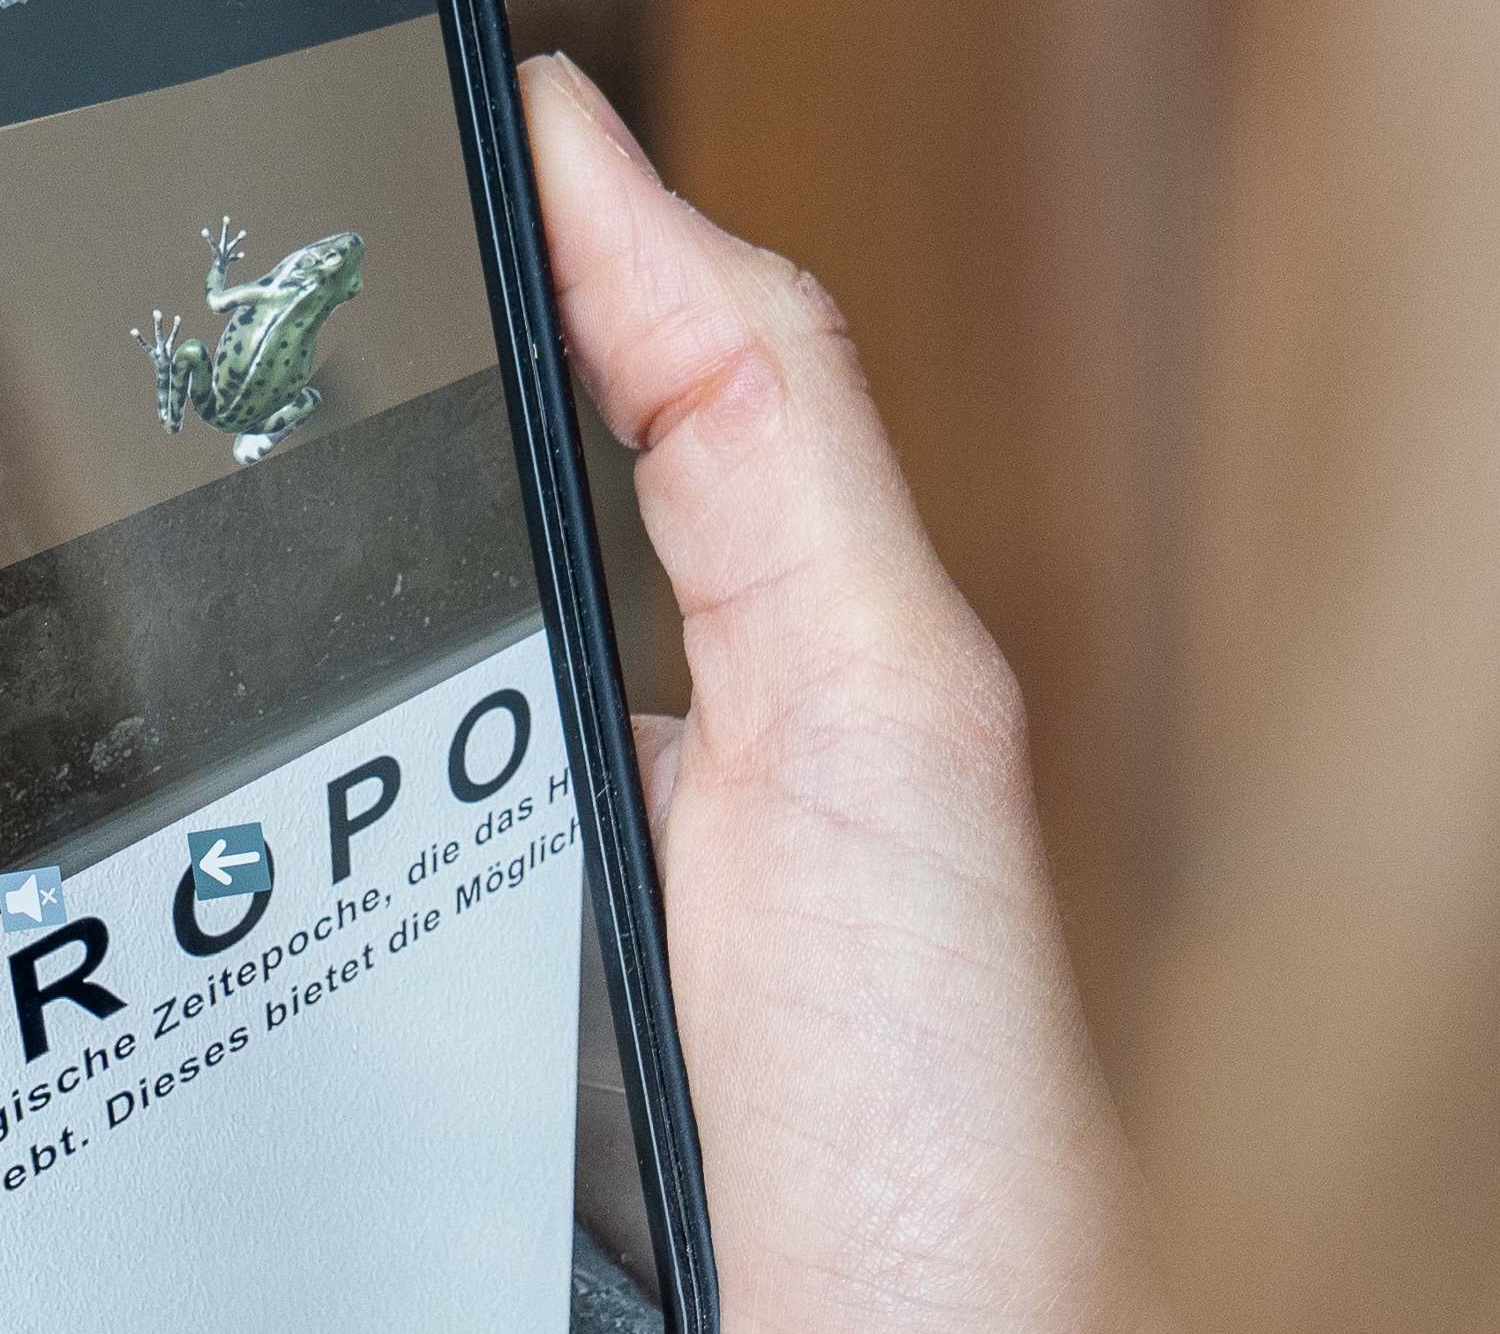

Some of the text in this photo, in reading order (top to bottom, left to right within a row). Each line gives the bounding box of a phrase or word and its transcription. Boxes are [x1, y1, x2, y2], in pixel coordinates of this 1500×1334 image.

[106, 1026, 249, 1129] Dieses
[265, 943, 374, 1032] bietet
[388, 908, 440, 954] die
[153, 887, 392, 1040] Zeitepoche,
[408, 841, 460, 886] die
[474, 796, 534, 847] das
